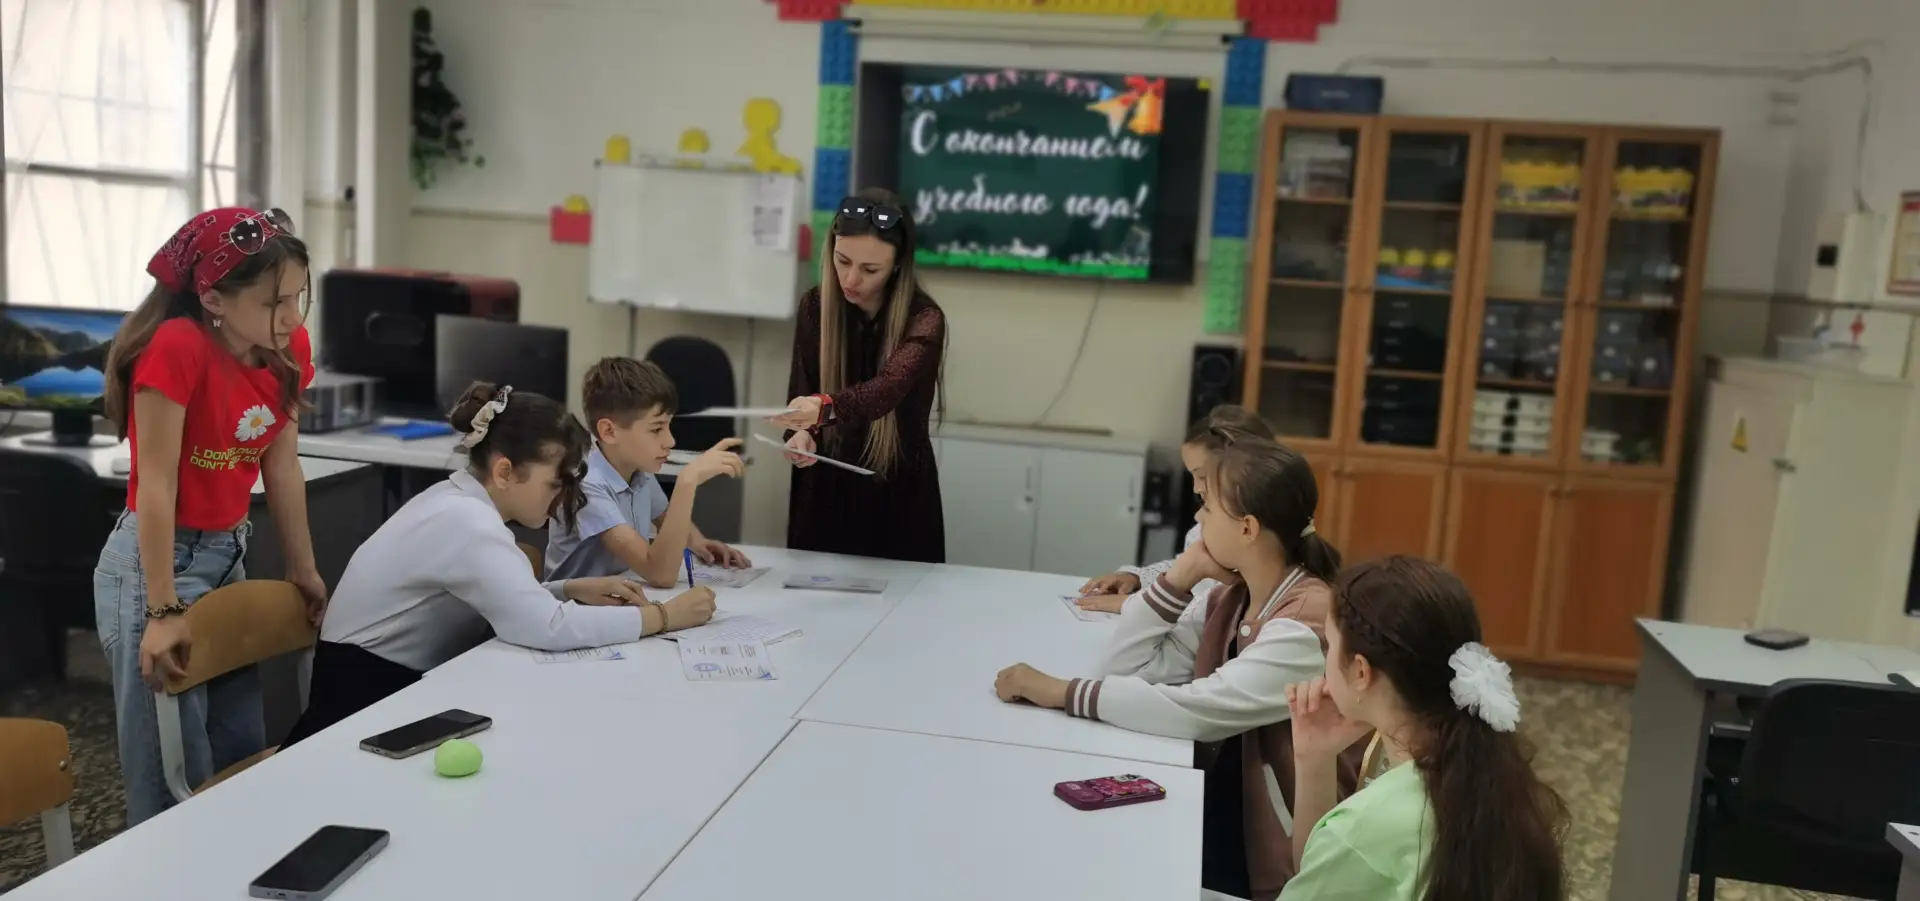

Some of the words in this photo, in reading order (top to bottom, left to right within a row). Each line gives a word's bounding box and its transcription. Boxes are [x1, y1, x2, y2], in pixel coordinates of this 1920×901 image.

[911, 109, 939, 156] С
[944, 129, 1148, 160] окончанием
[914, 173, 1051, 224] учебного
[1064, 182, 1149, 229] года!
